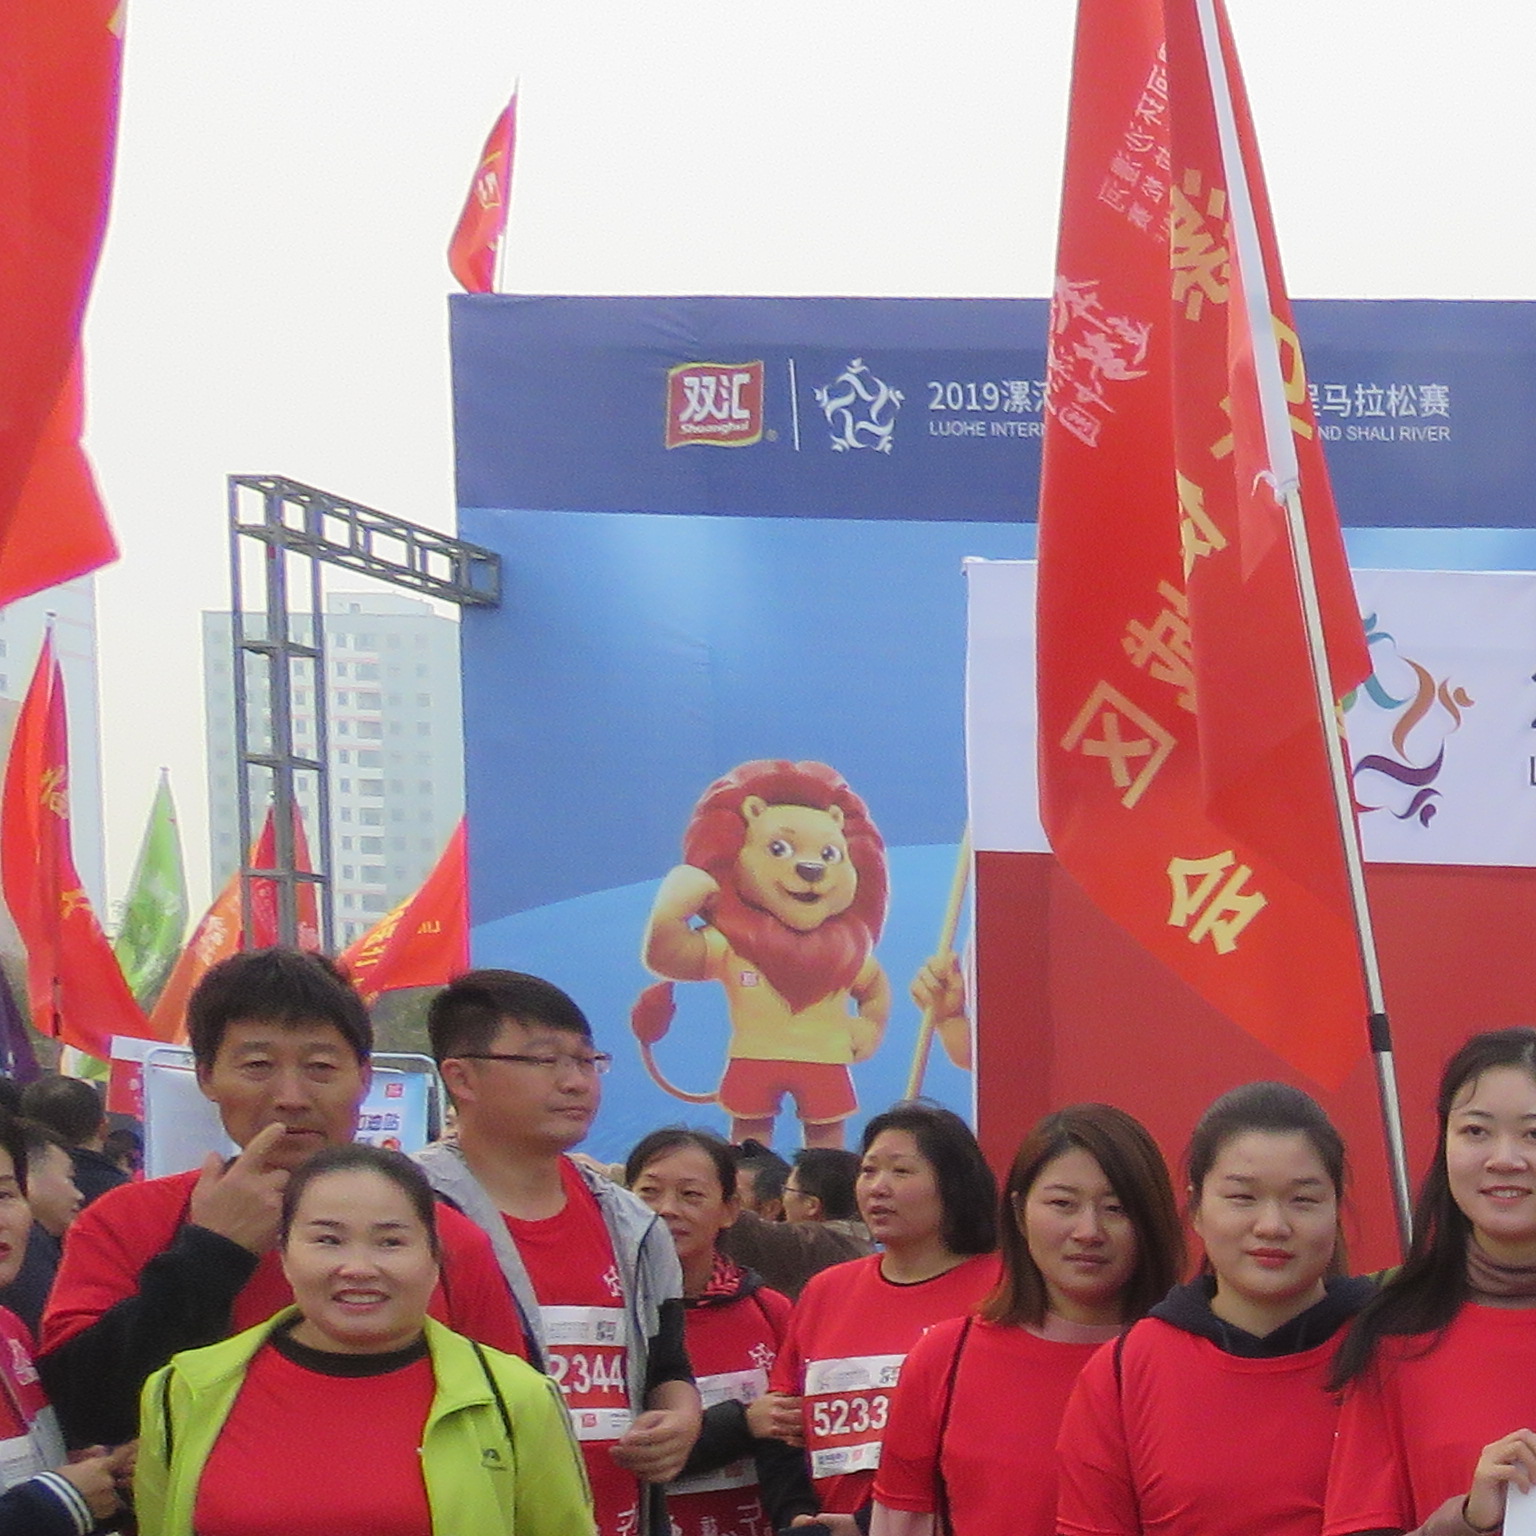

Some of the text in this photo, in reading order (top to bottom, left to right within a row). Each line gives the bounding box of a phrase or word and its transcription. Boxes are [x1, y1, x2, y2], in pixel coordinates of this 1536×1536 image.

[680, 375, 751, 422] 双汇
[929, 420, 987, 437] LUOHE
[1346, 425, 1394, 442] SHALI
[1400, 425, 1450, 442] RIVER
[811, 1395, 890, 1437] 5233
